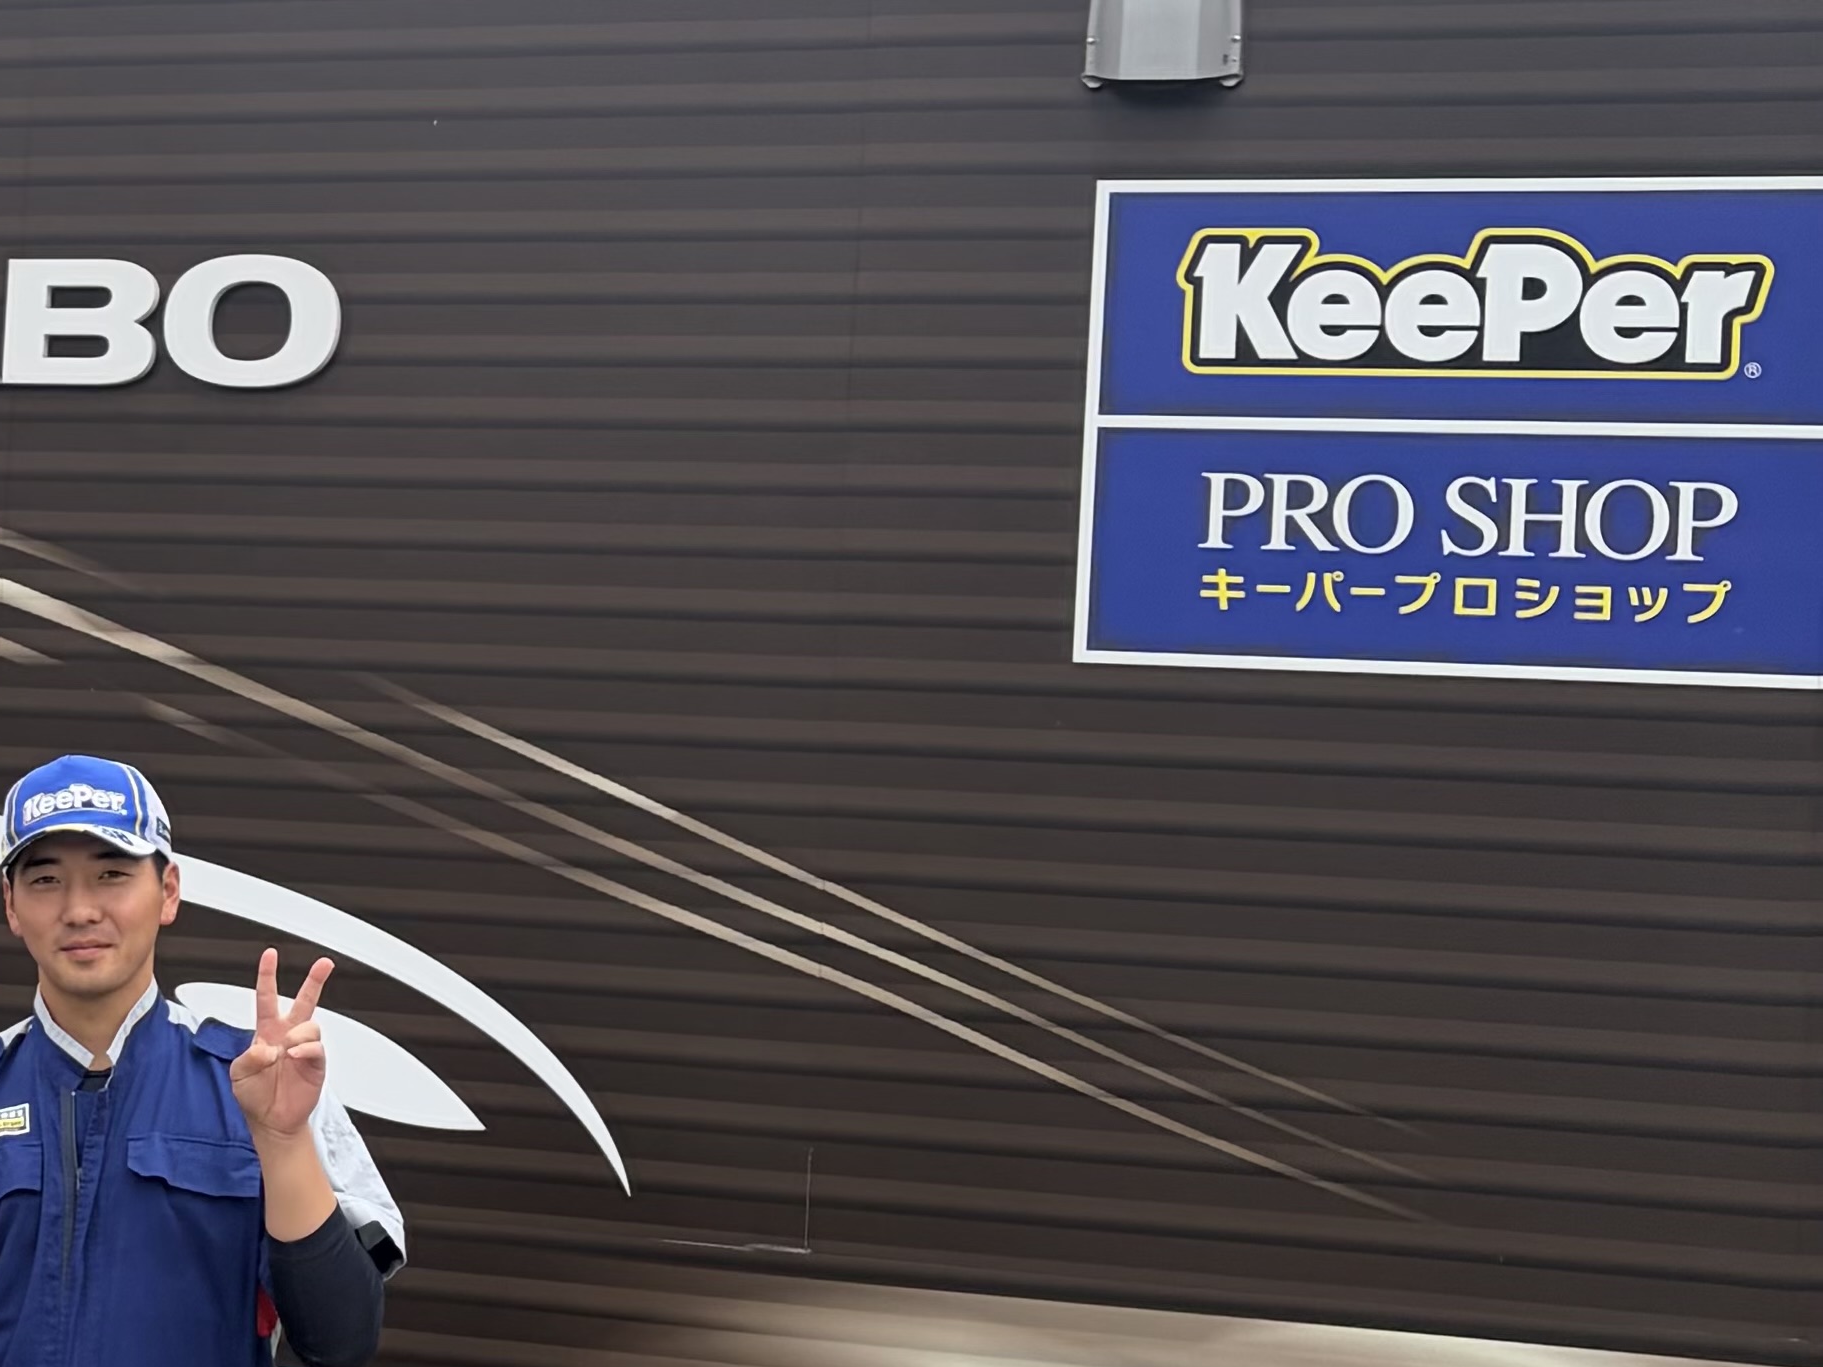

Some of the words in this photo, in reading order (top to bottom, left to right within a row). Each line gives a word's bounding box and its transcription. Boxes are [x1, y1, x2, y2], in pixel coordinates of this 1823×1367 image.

[1189, 238, 1760, 368] KeePer
[1197, 471, 1415, 554] PRO
[1440, 476, 1739, 562] SHOP
[1199, 567, 1732, 624] キーパープロショップ
[23, 784, 127, 823] KeePer
